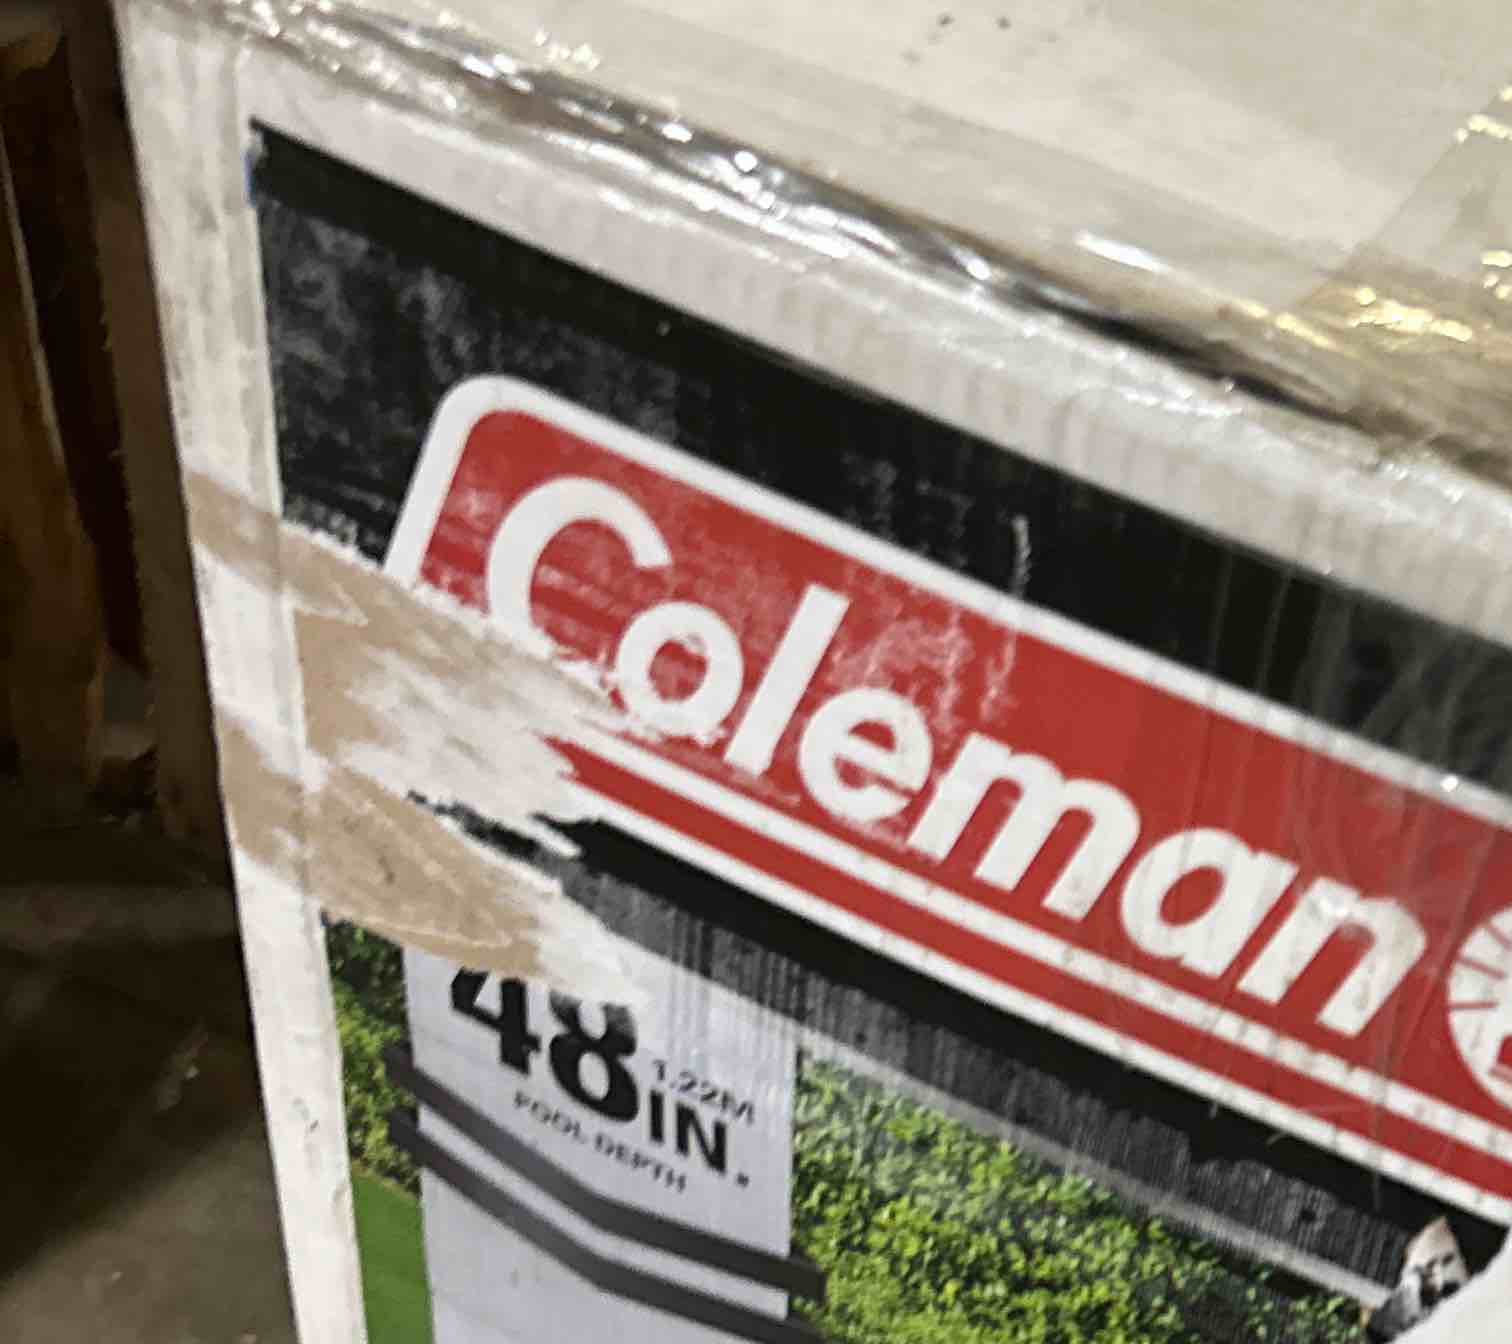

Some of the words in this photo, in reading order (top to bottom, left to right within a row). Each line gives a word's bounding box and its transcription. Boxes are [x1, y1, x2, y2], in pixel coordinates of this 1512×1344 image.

[488, 476, 1426, 1036] Coleman
[514, 1090, 588, 1145] POOL
[594, 1133, 687, 1193] DEPTH
